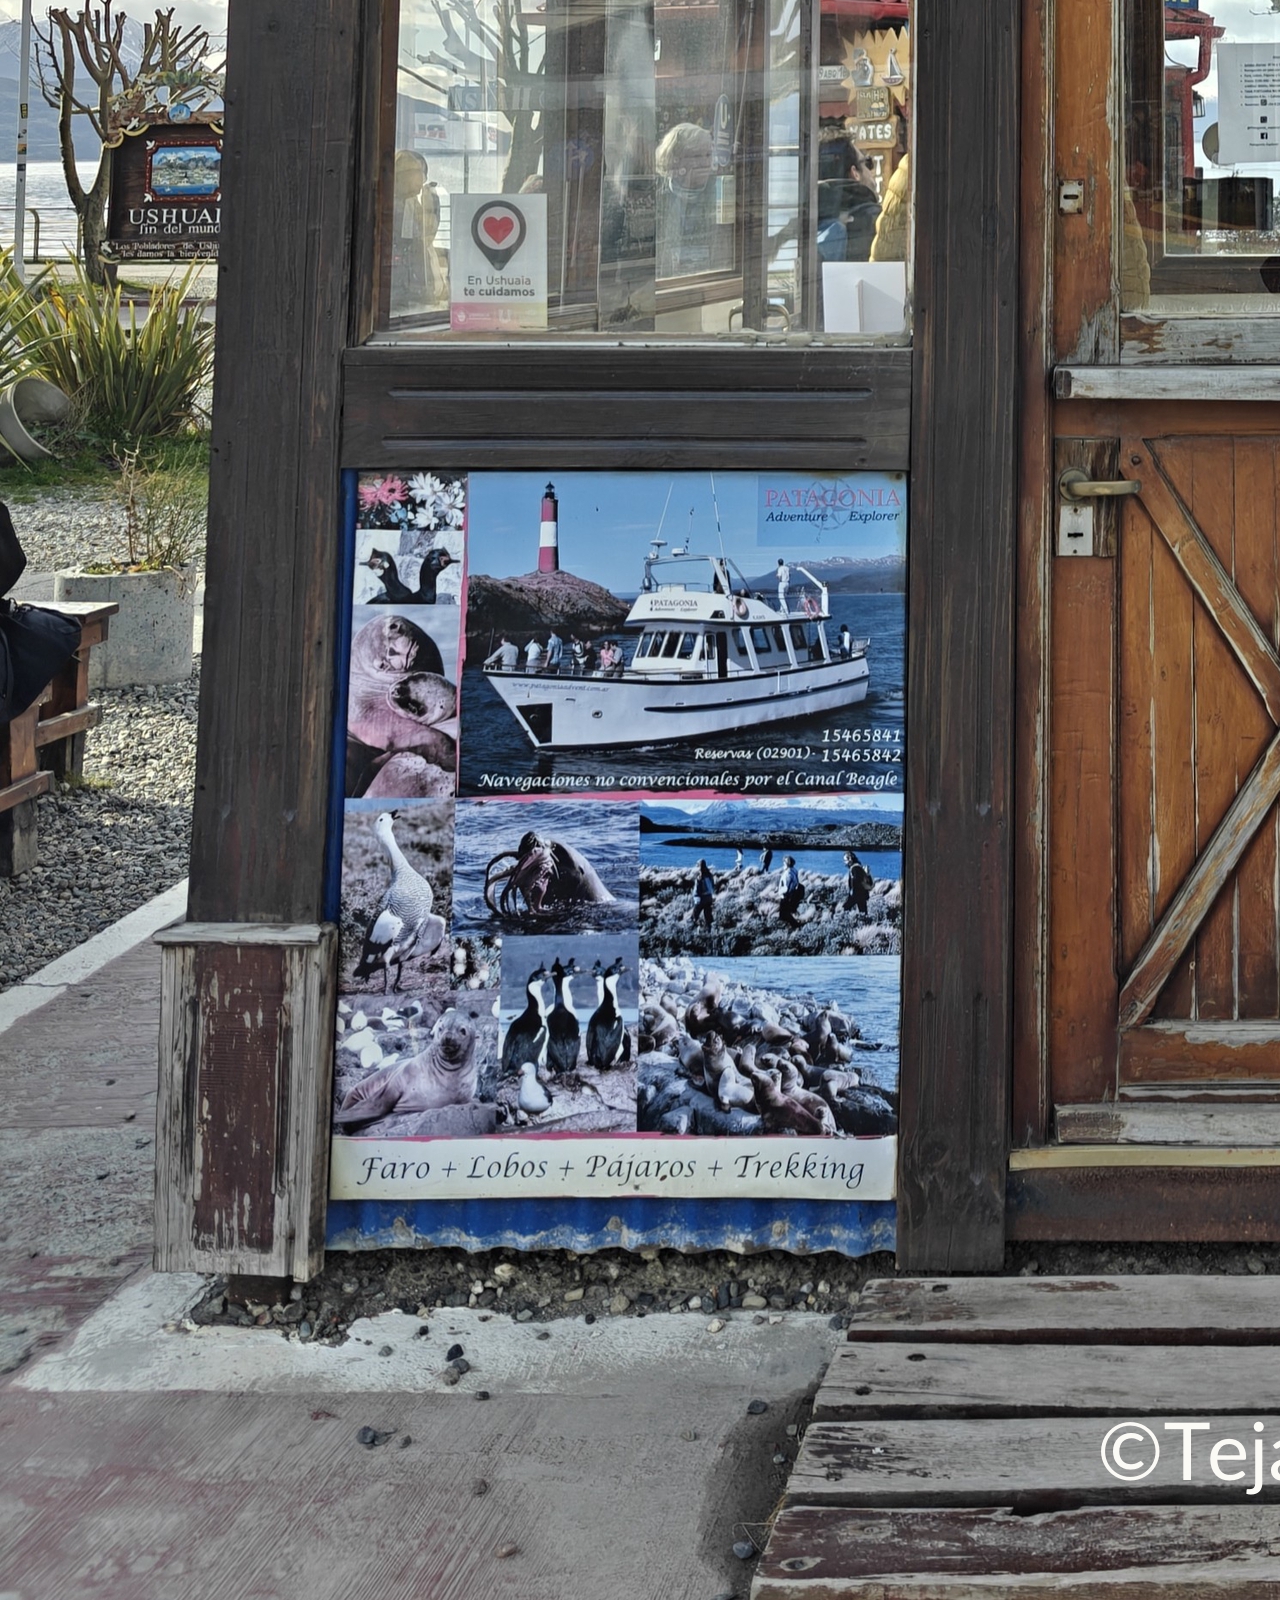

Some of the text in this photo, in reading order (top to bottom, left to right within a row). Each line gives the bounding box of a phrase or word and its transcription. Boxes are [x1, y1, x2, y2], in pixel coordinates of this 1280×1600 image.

[163, 223, 182, 234] del
[467, 275, 532, 286] En Ushuaia
[463, 286, 536, 297] te cuidamos
[764, 488, 902, 508] PATAGONIA
[766, 510, 900, 524] Adventure Explorer
[653, 599, 698, 607] PATAGONIA
[821, 728, 901, 743] 15465841
[694, 747, 754, 760] Reservas
[821, 748, 902, 763] 15465842
[477, 770, 899, 791] Navegaciones no convencionales por el Canal Beagle
[355, 1154, 431, 1186] Faro
[466, 1151, 549, 1179] Lobos
[586, 1152, 697, 1186] Pájaros
[734, 1151, 866, 1189] Trekking
